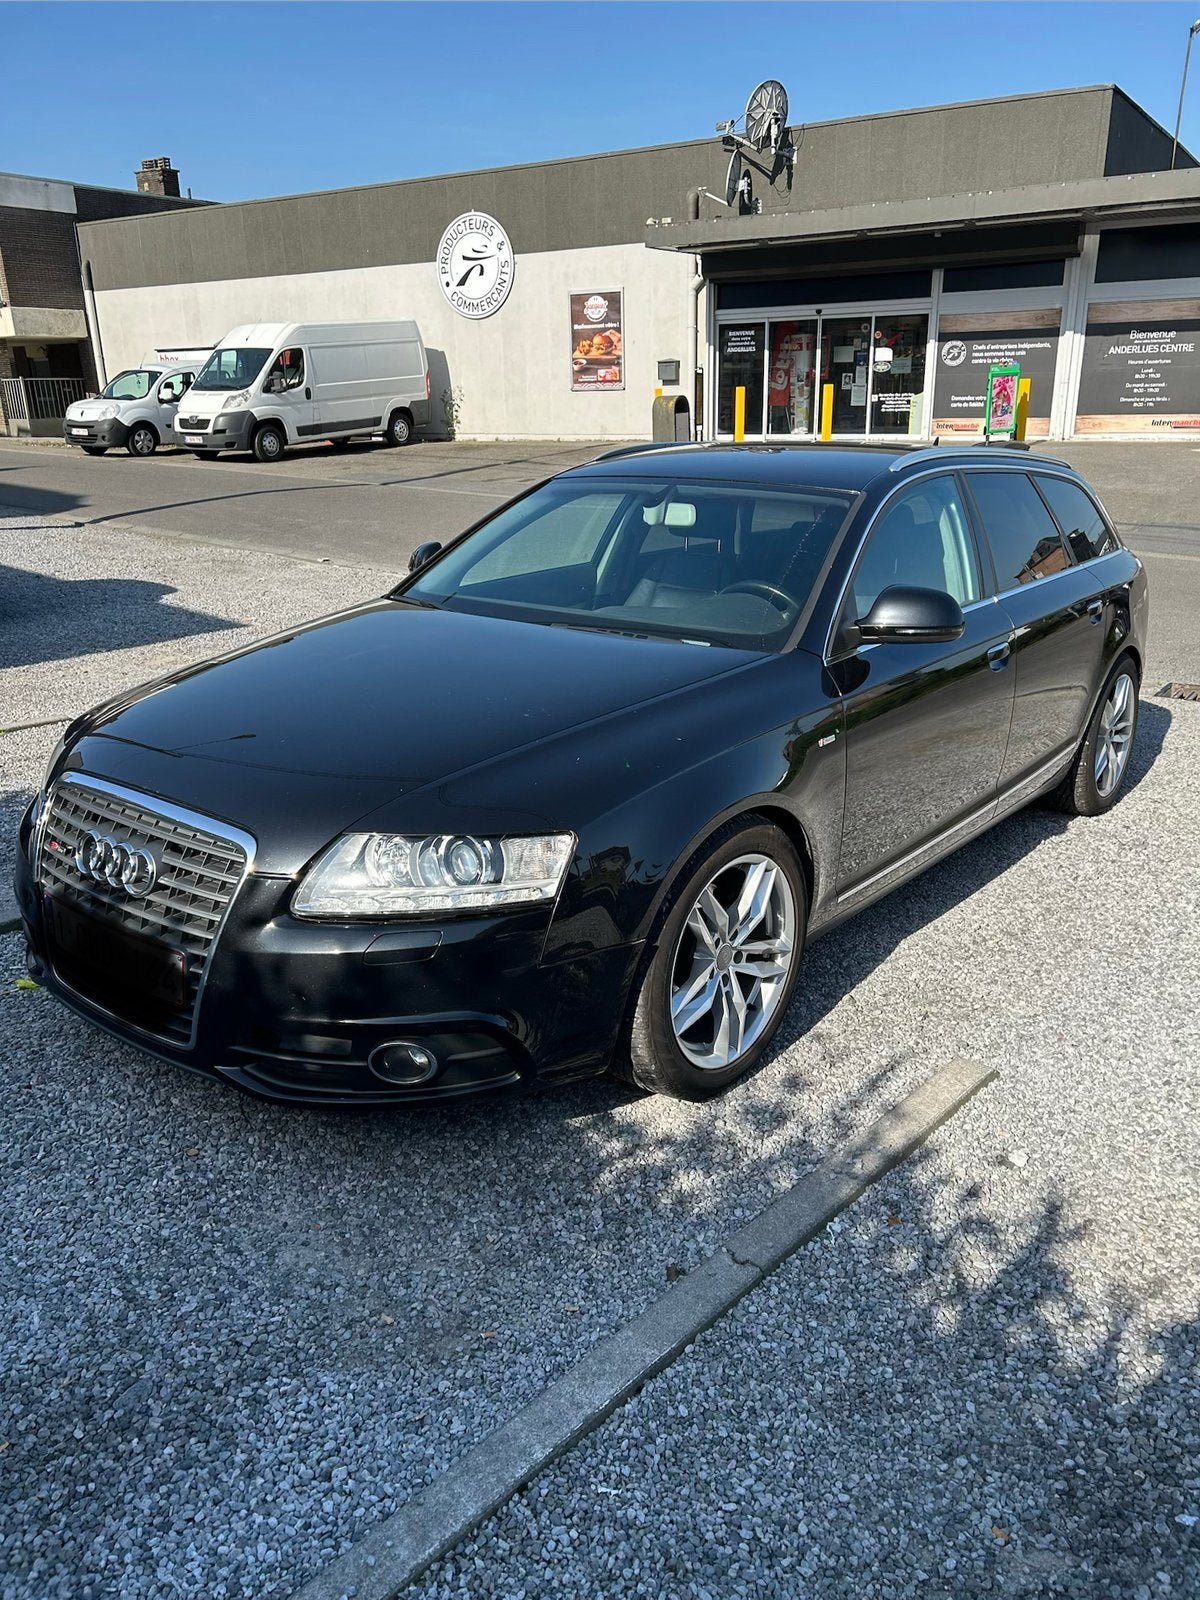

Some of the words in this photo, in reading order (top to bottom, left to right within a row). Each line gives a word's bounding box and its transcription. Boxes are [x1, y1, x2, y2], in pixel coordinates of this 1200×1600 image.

[441, 219, 496, 275] PRODUCTEURS
[496, 241, 505, 251] &
[1130, 330, 1177, 340] Bienvenue
[1108, 344, 1159, 354] ANDERLUES
[1160, 343, 1195, 353] CENTRE
